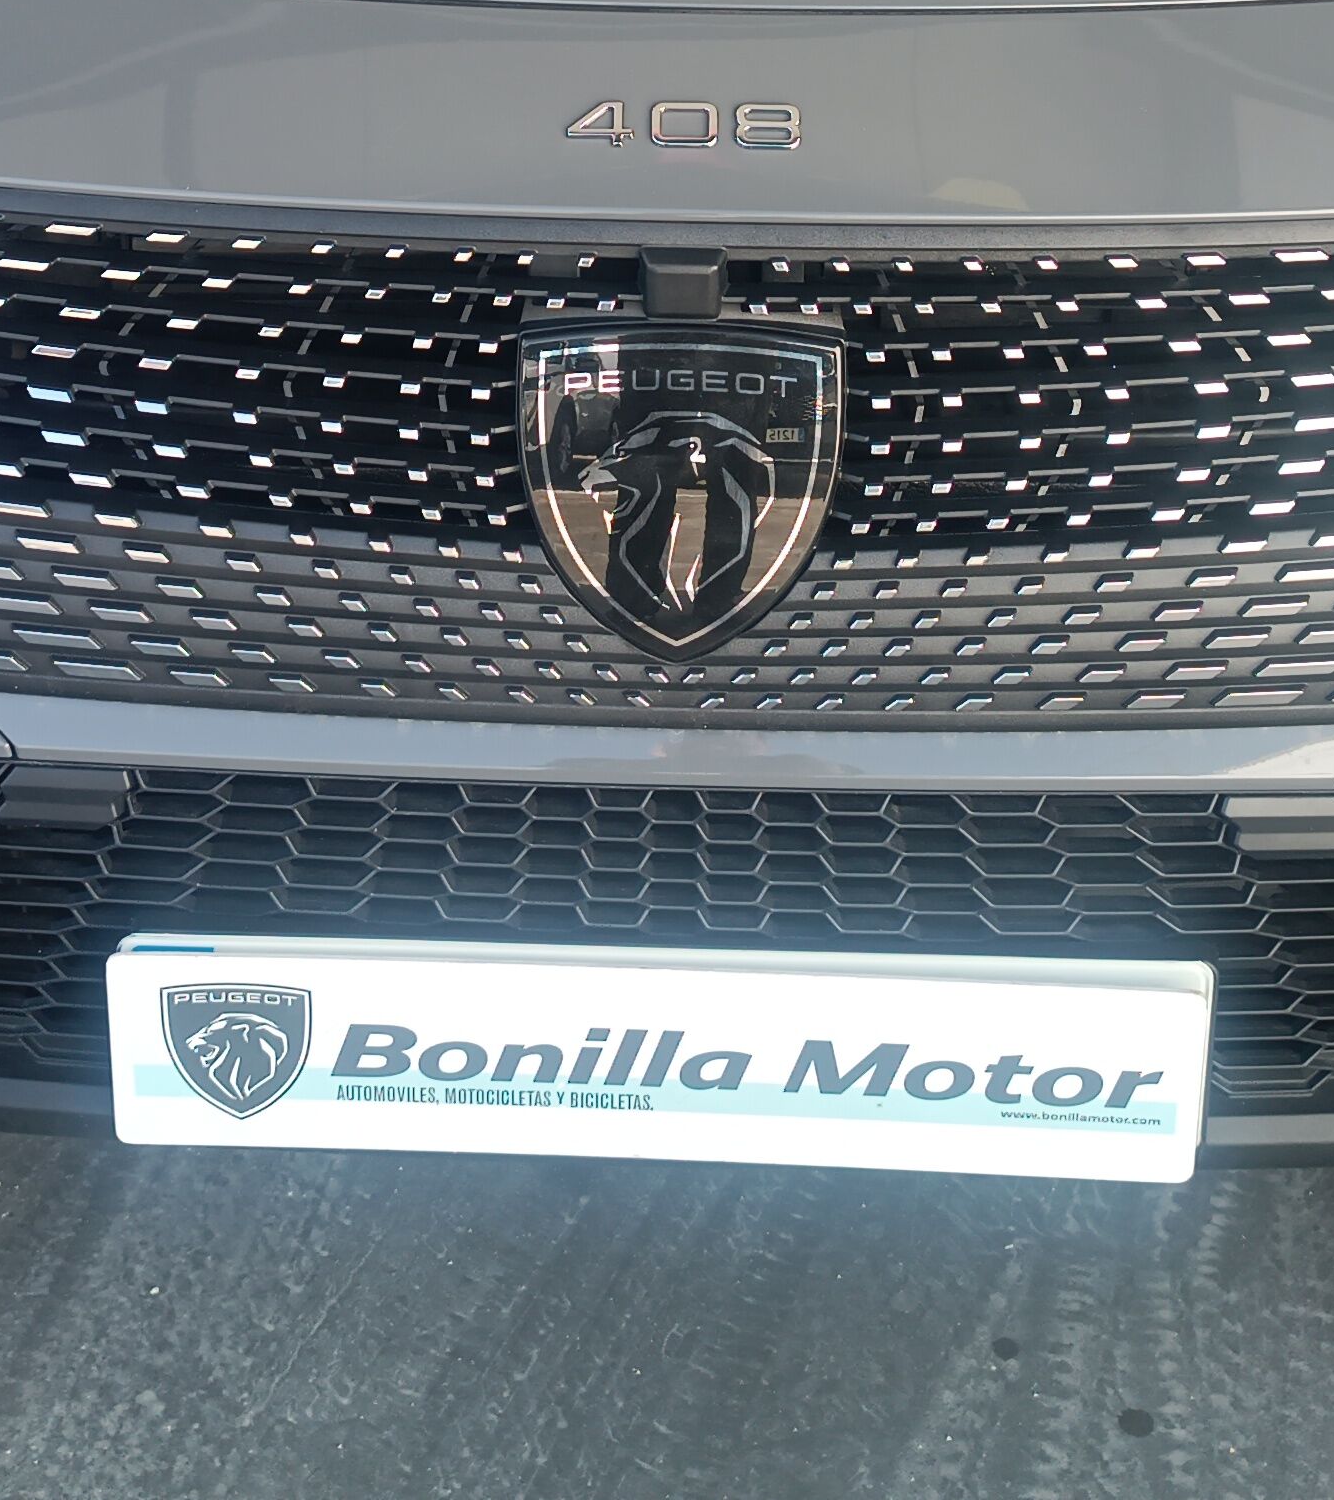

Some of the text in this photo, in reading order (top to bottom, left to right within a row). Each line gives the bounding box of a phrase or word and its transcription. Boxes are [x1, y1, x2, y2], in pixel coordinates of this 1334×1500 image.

[566, 100, 802, 150] 408
[564, 369, 798, 398] PEUGEOT
[174, 991, 299, 1007] PEUGEOT
[331, 1022, 1164, 1111] Bonilla Motor
[336, 1084, 654, 1112] AUTOMOVILES, MOTOCICLETAS Y BICICLETAS.
[1000, 1109, 1162, 1126] www.bonillamotor.com
